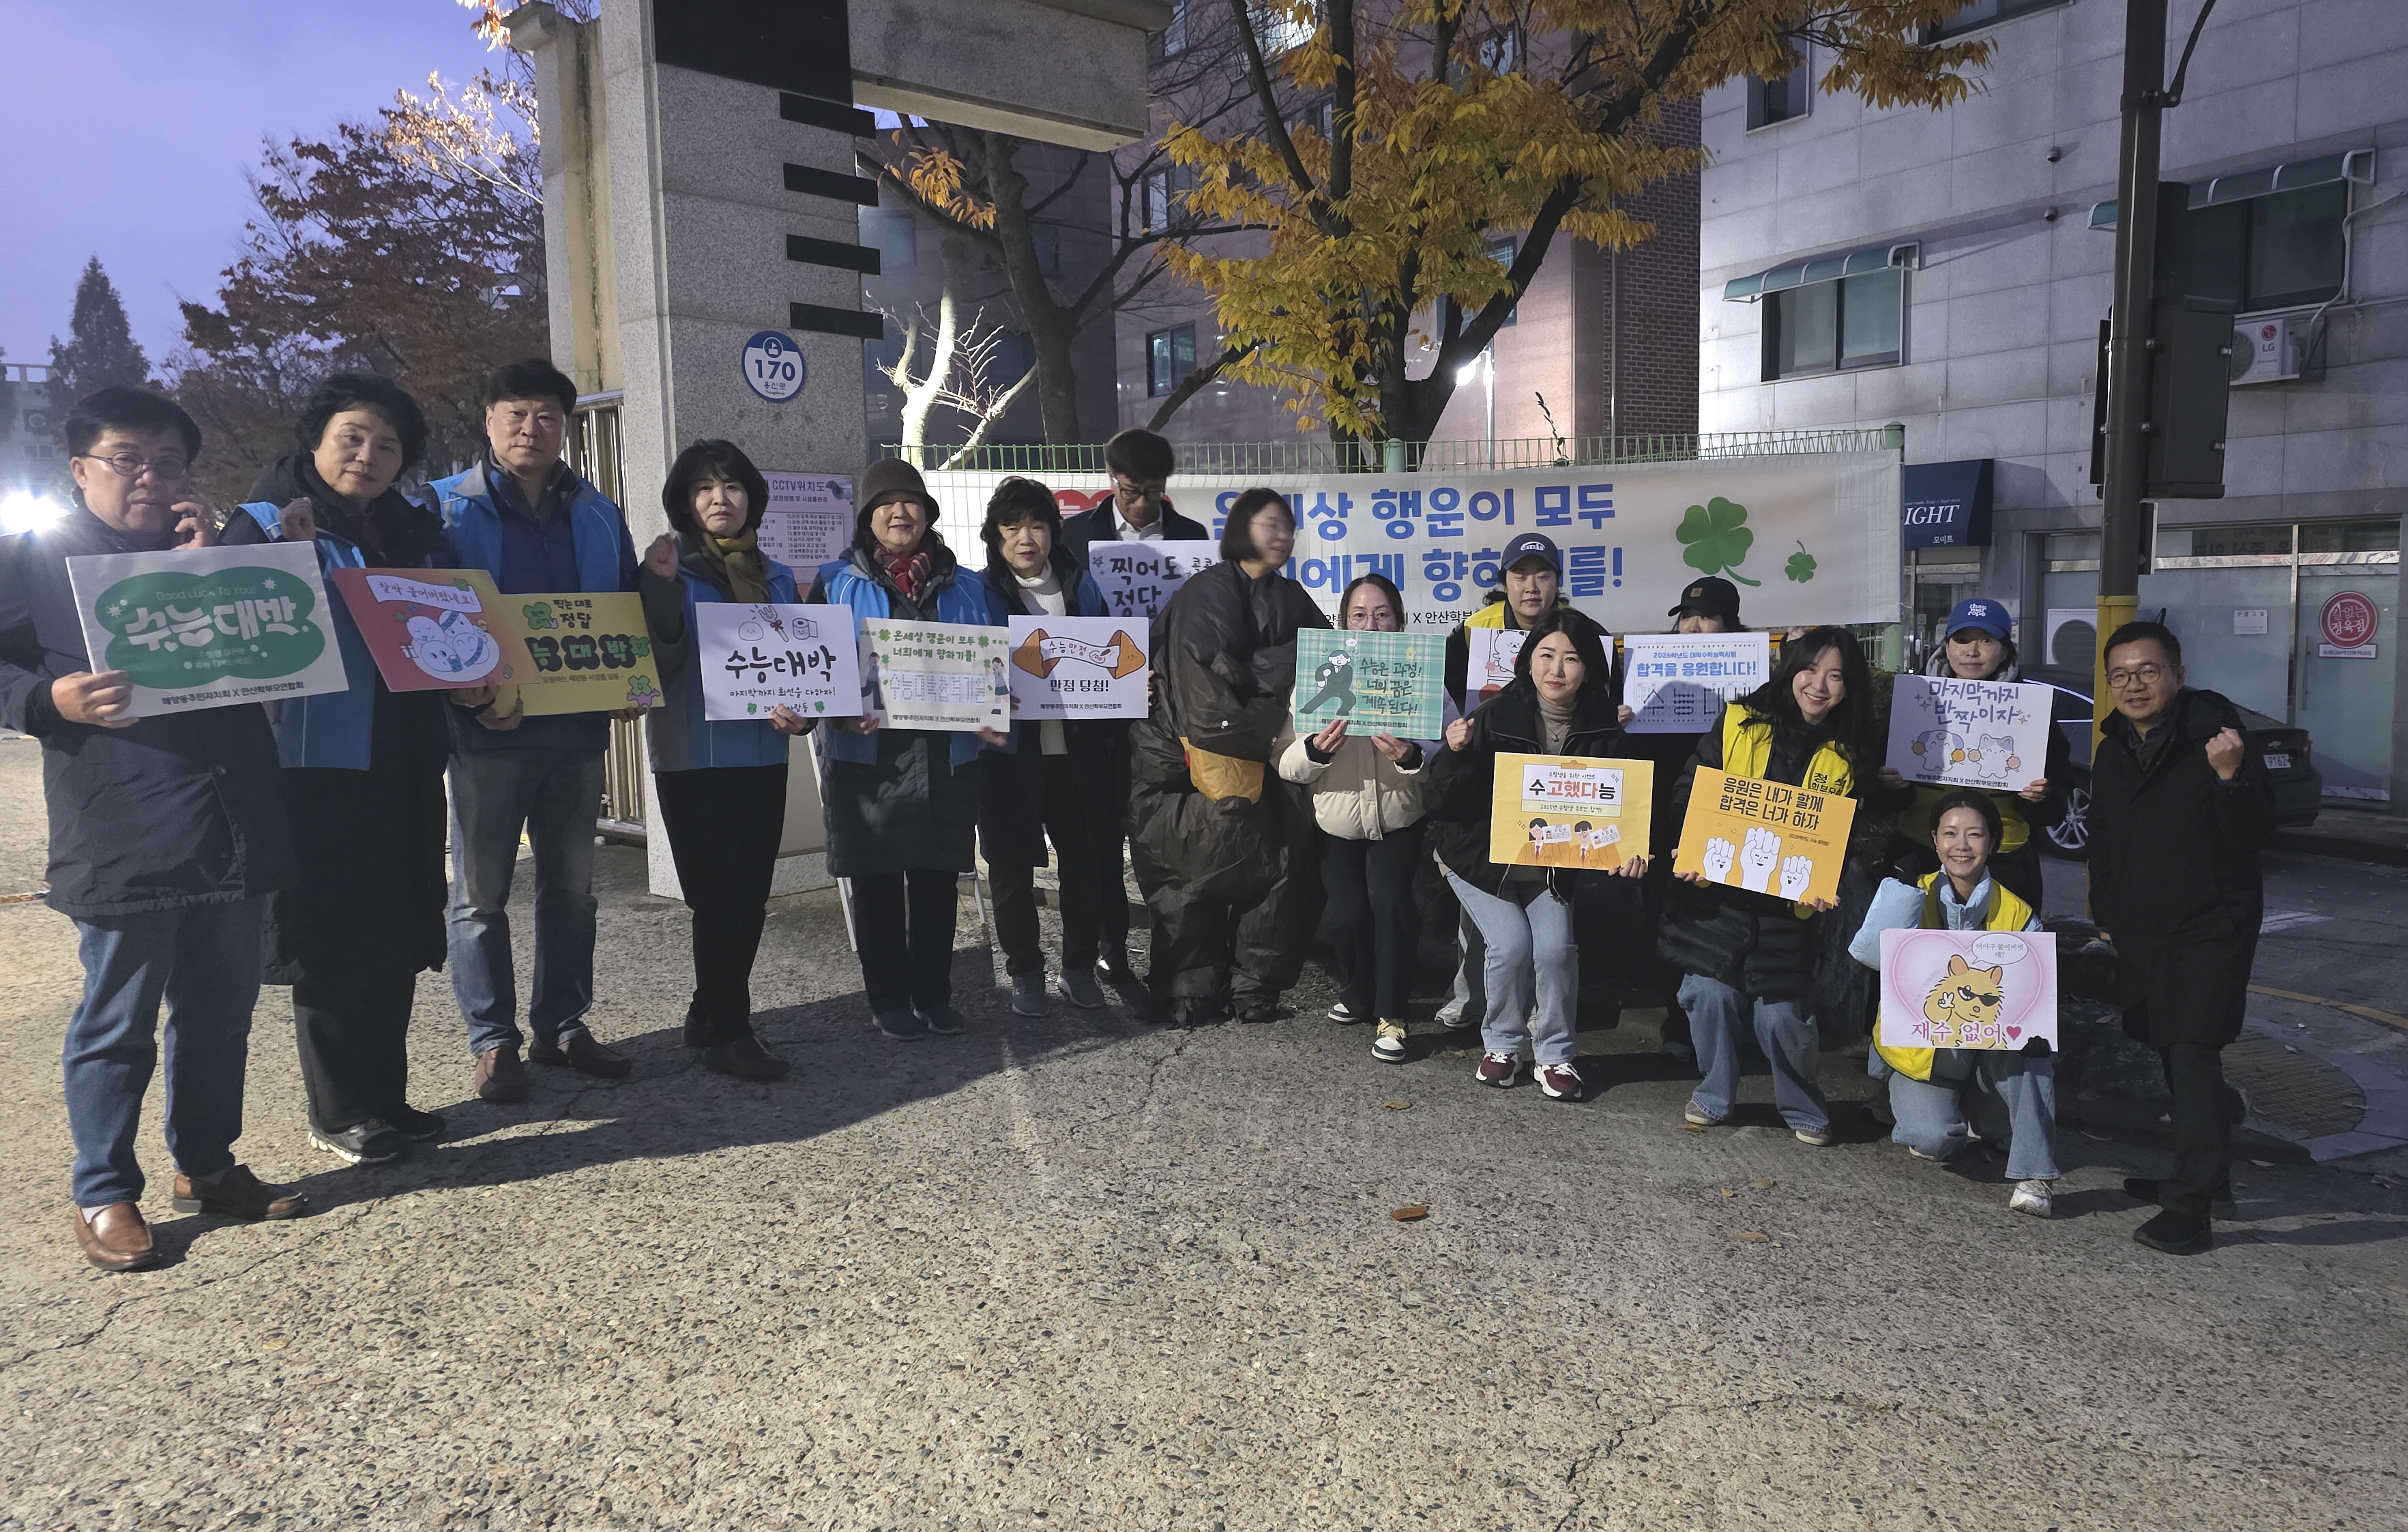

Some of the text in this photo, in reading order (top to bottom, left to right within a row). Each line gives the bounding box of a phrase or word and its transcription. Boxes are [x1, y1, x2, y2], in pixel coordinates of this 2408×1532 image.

[2263, 343, 2275, 352] LG
[755, 359, 795, 381] 170
[763, 381, 786, 390] 용신로
[772, 480, 825, 492] CCTV위치도
[1371, 488, 1514, 539] 행운이
[1535, 484, 1616, 530] 모두
[1904, 505, 1960, 525] IGHT
[1933, 535, 1954, 544] 모이트
[1110, 555, 1182, 585] 찍어도
[1423, 546, 1622, 602] 향하를!
[156, 591, 186, 601] Good
[1112, 586, 1162, 618] 정답
[125, 595, 299, 651] 수능대박
[559, 612, 592, 630] 정답
[1413, 613, 1422, 623] X
[2332, 618, 2365, 636] 정육점
[893, 630, 975, 646] 온세상 행운이 모두
[893, 647, 976, 662] 너희에게 향하기를!
[1049, 640, 1066, 654] 수능
[1068, 643, 1087, 657] 만점
[725, 645, 837, 684] 수능대박
[1360, 658, 1422, 678] 수능은 과정!
[1637, 661, 1757, 677] 합격을 응원합니다!
[730, 686, 836, 698] 마지막까지 최선을 다하자!
[1050, 679, 1109, 692] 만점 당첨!
[1367, 679, 1413, 698] 너의 꿈은
[1929, 679, 2019, 706] 마지막까지
[1935, 701, 2017, 734] 반짝이자
[1529, 779, 1616, 800] 수고했다능
[1724, 777, 1824, 812] 응원은 내가 할께
[1719, 795, 1819, 831] 합격은 너가 하자
[1911, 1021, 2002, 1044] 재수 없어
